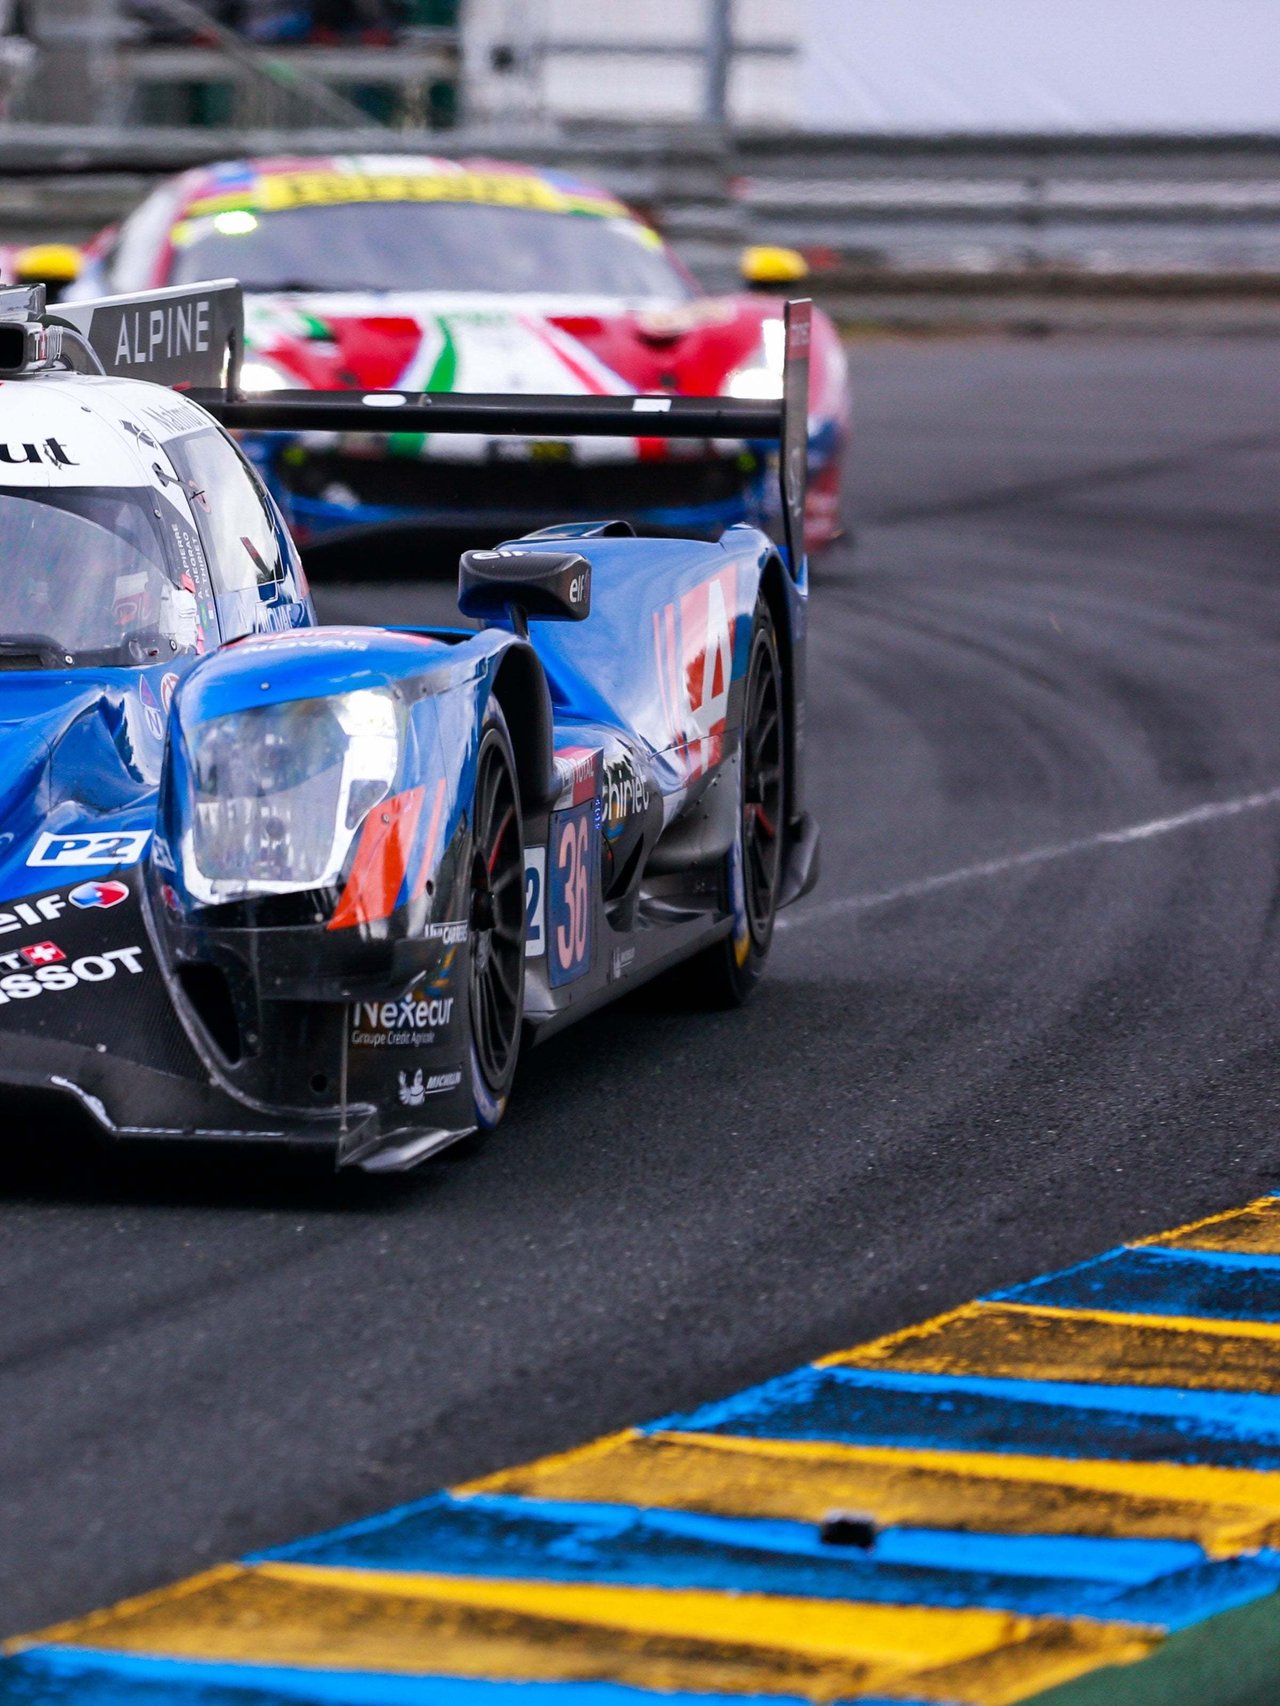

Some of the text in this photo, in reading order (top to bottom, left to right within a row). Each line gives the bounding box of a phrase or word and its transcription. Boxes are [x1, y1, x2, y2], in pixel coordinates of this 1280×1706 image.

[115, 301, 209, 366] ALPINE
[171, 523, 192, 578] APIERRE
[569, 575, 585, 603] elf
[41, 838, 136, 860] P2
[525, 867, 541, 940] 2
[558, 816, 588, 969] 36
[352, 1030, 386, 1047] Groupe
